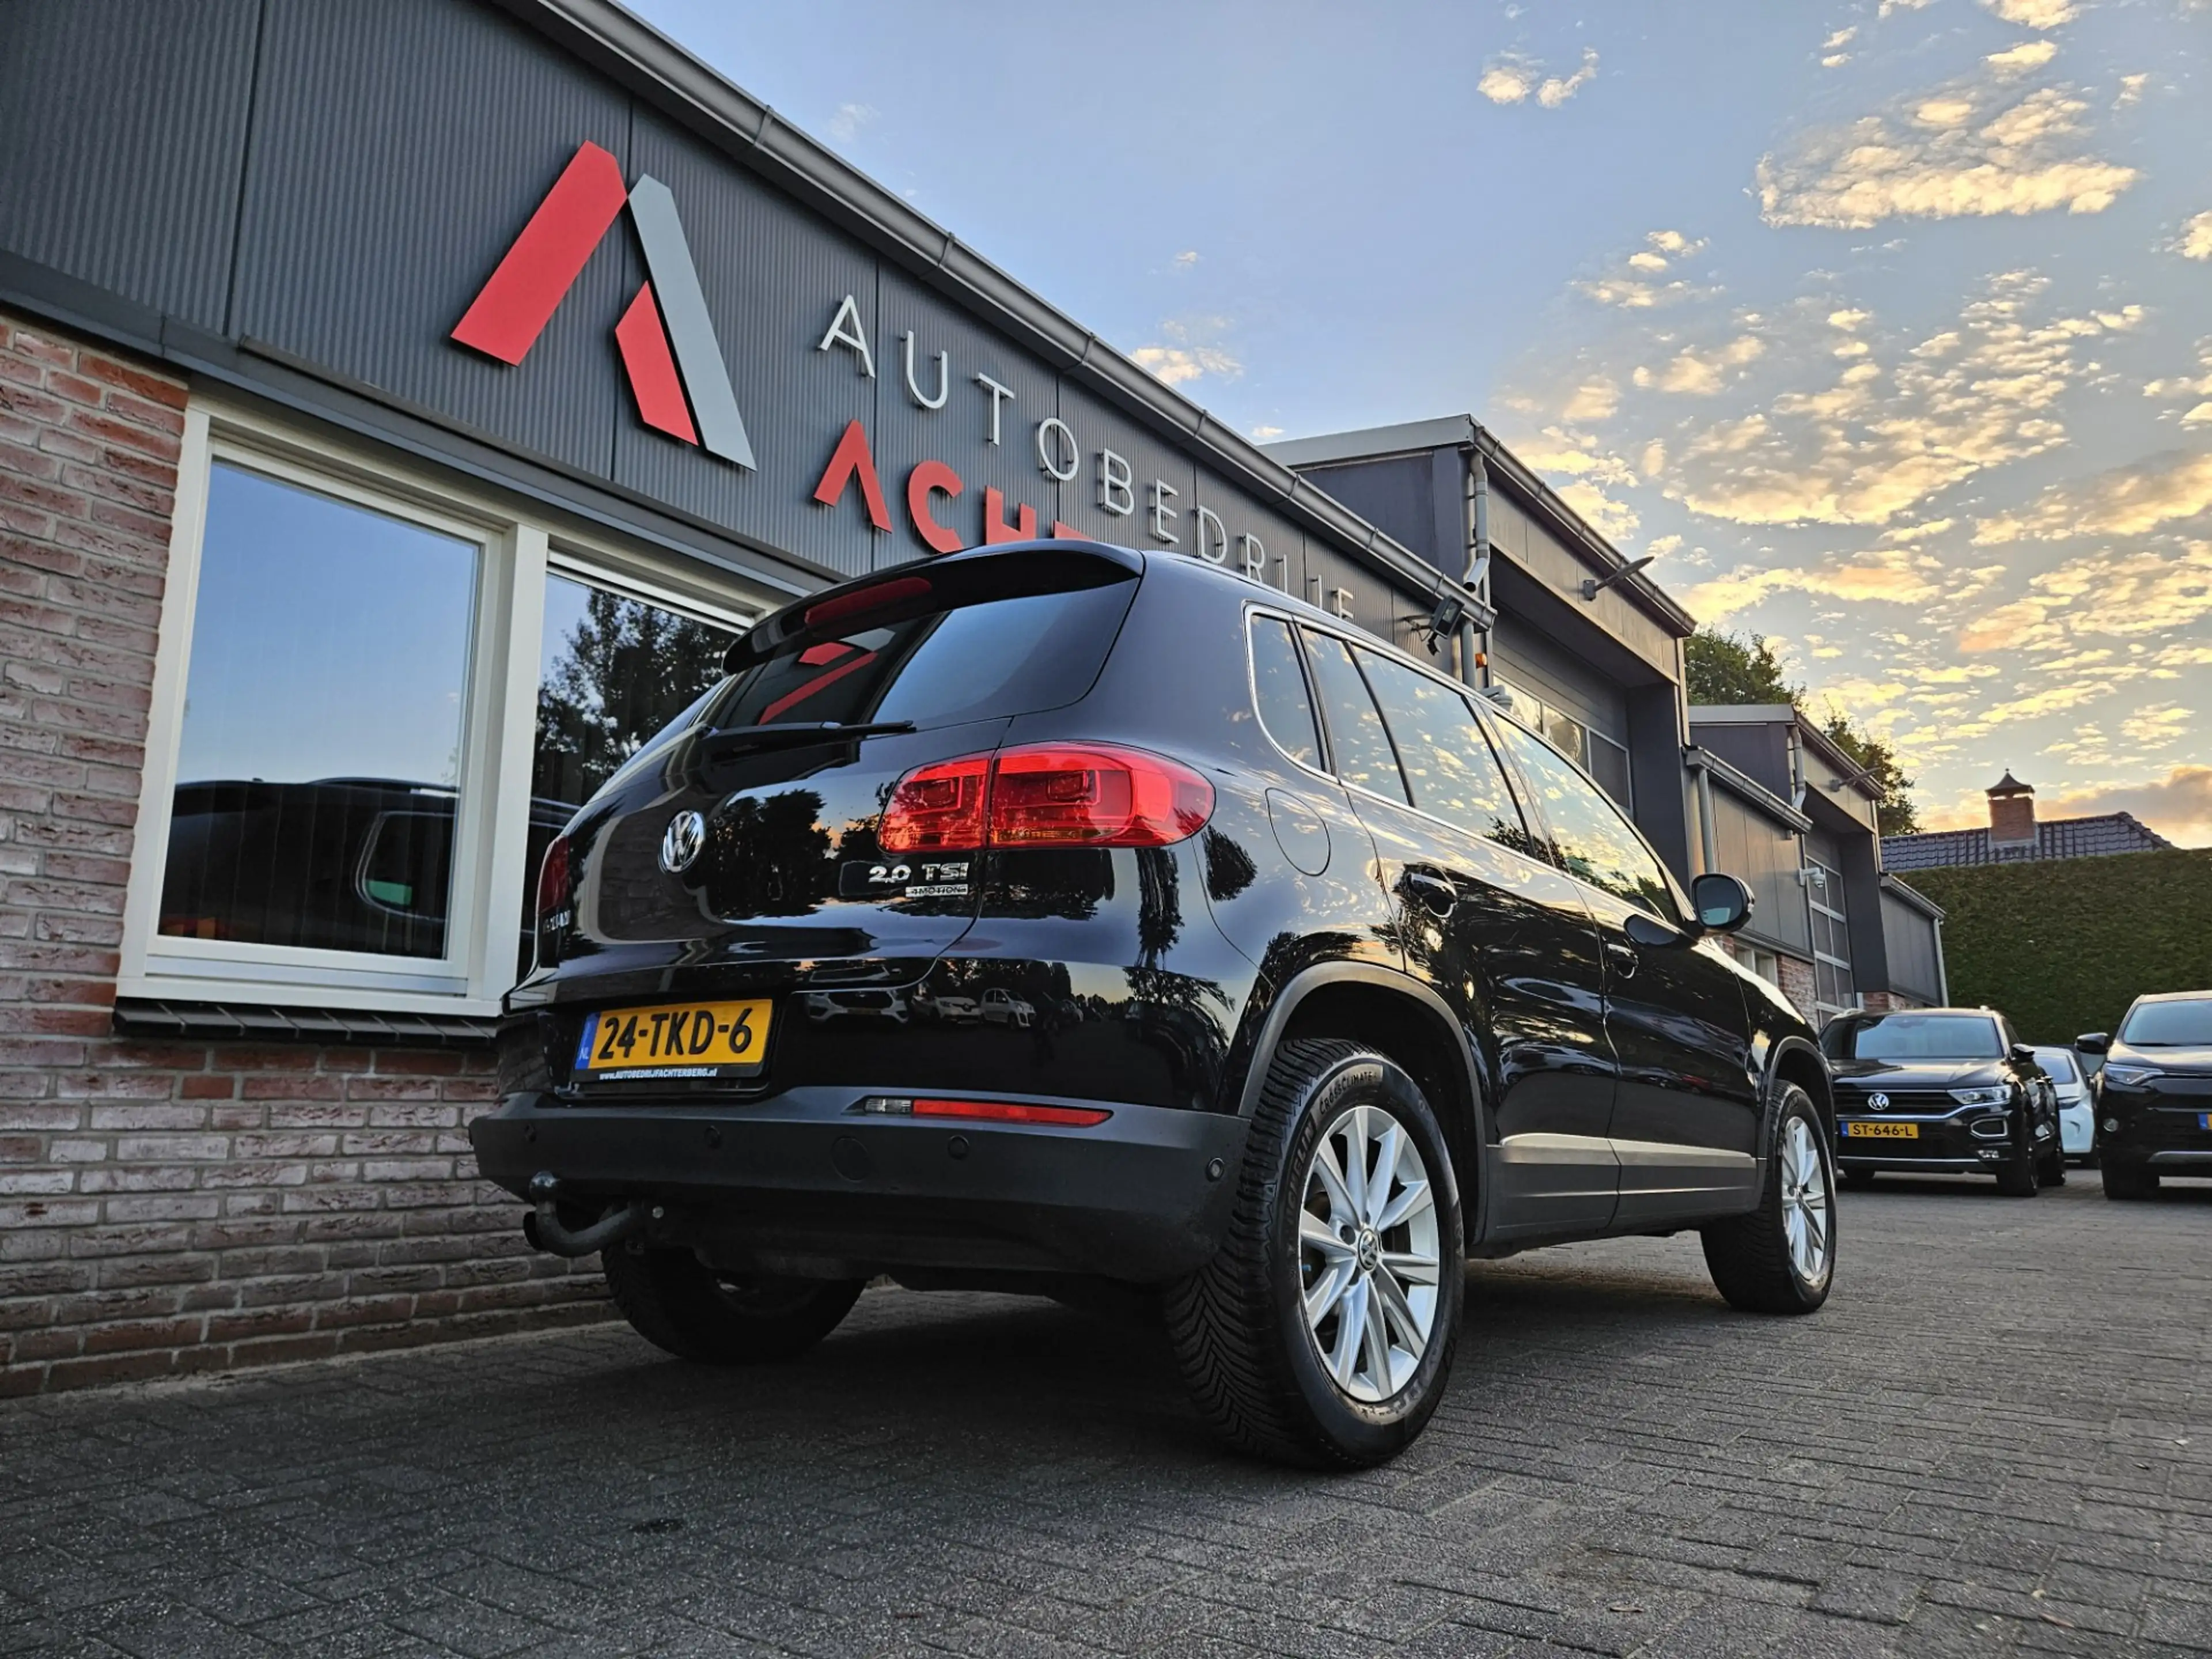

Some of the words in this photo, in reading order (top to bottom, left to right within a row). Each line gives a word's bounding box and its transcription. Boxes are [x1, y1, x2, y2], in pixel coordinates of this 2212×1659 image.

[922, 862, 969, 881] TSI
[597, 1007, 753, 1060] 24-TKD-6
[1853, 1124, 1913, 1137] ST-646-L
